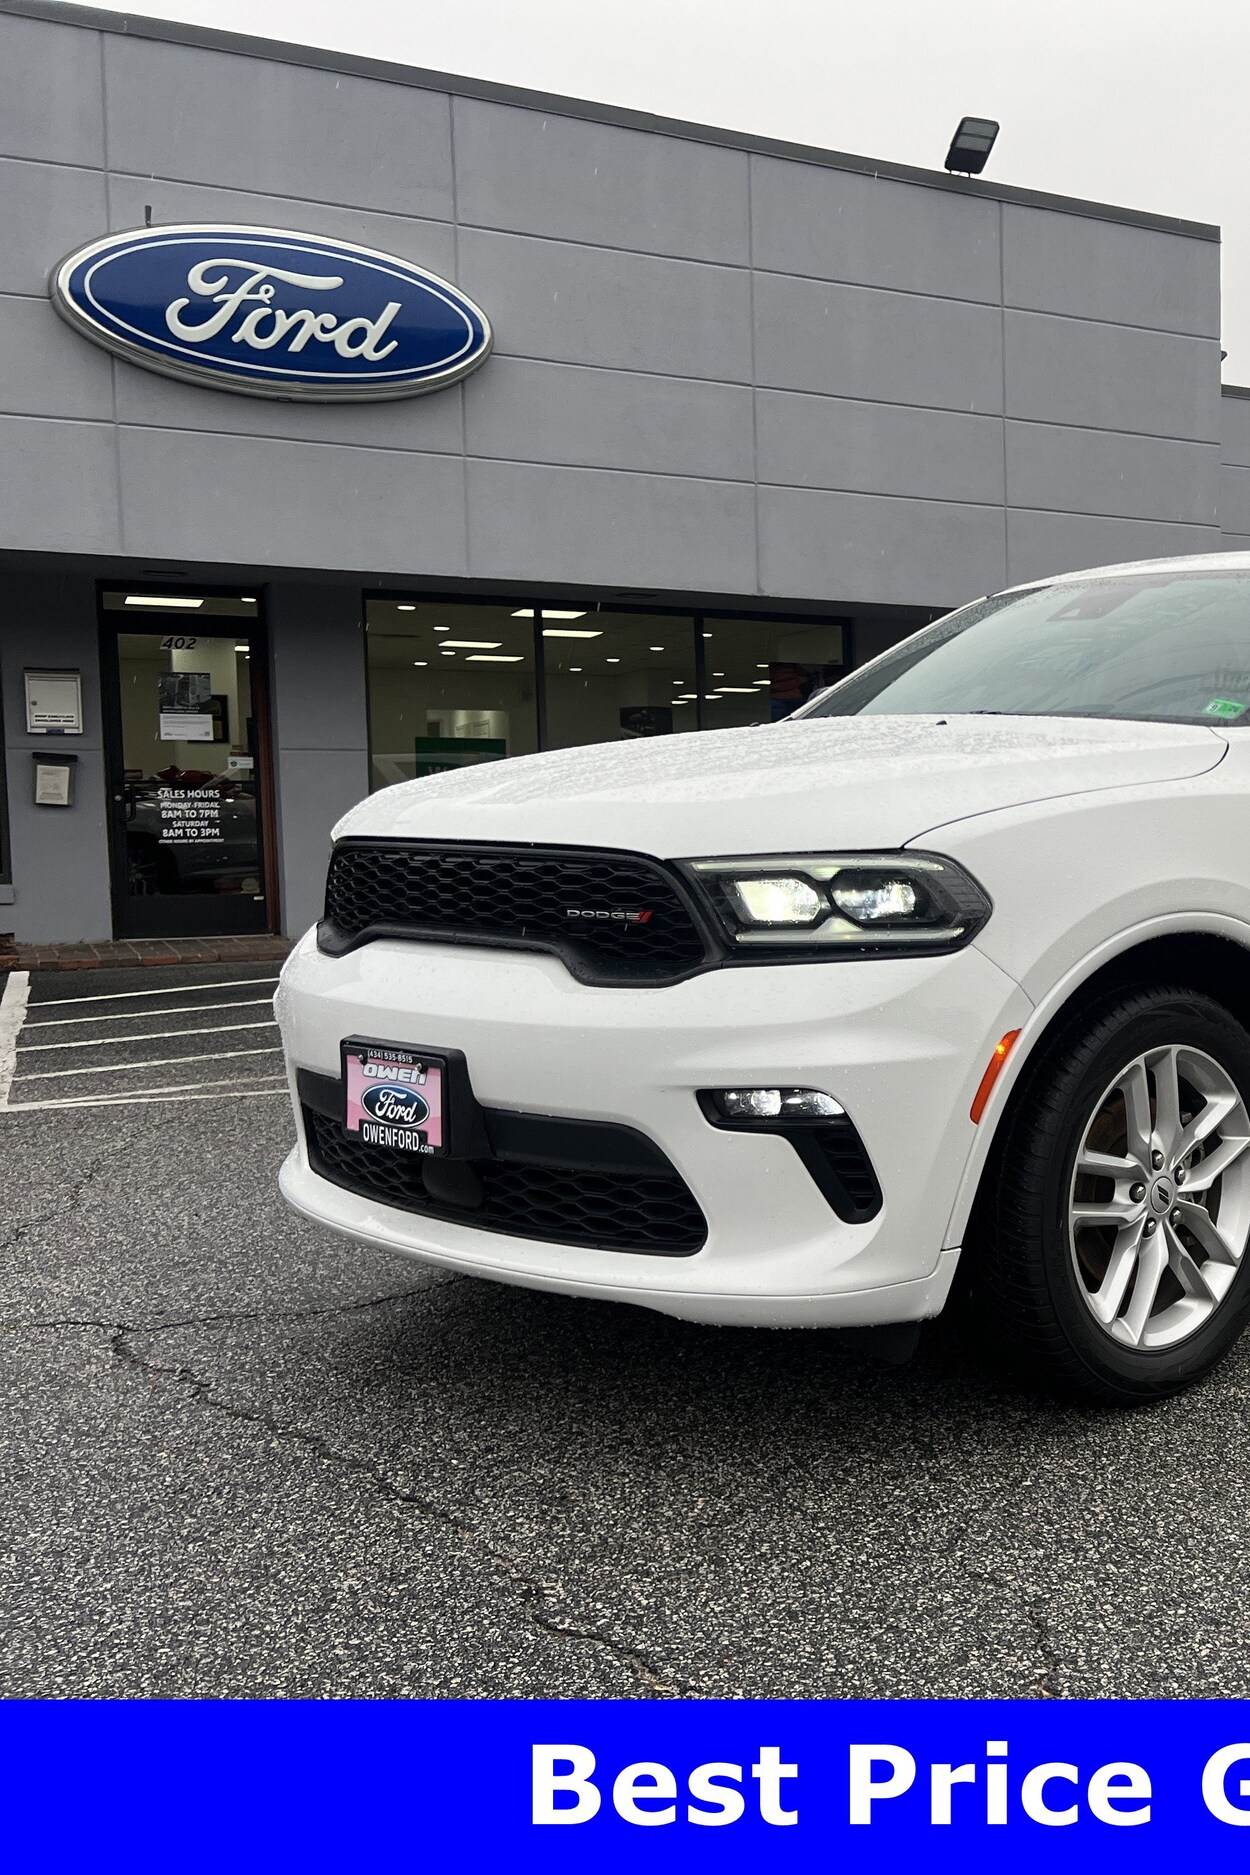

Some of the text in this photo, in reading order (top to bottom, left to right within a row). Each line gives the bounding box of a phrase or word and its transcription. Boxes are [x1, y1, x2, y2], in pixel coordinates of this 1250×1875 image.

[165, 258, 402, 361] Ford
[162, 637, 197, 649] 402
[157, 789, 220, 799] SALES HOURS
[161, 809, 219, 818] 8AM TO 7PM
[162, 828, 220, 837] 8AM TO 3PM
[567, 909, 640, 920] DODGE
[375, 1088, 418, 1123] Ford
